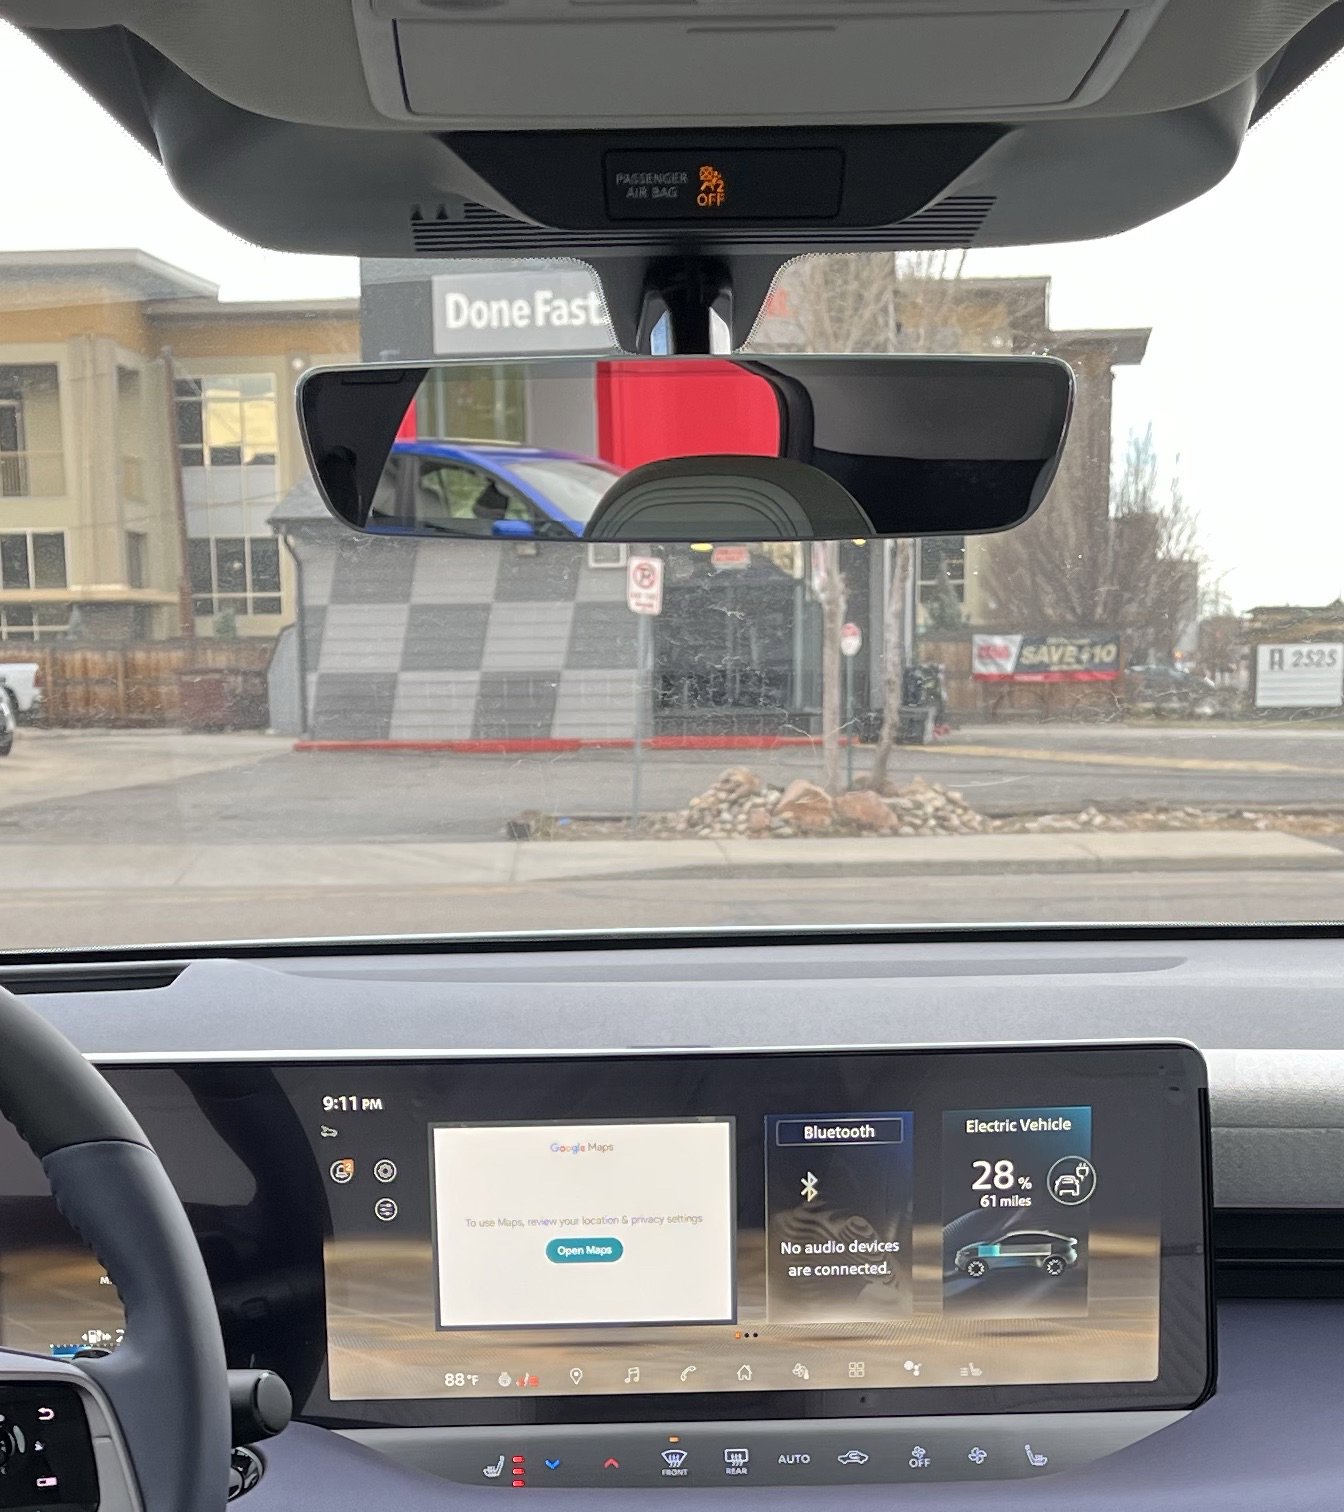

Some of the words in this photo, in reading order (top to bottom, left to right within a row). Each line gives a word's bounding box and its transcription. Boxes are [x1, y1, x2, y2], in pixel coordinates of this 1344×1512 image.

[616, 171, 689, 184] PASSENGER
[626, 187, 648, 199] AIR
[651, 187, 678, 199] BAG
[697, 193, 725, 207] OFF
[444, 291, 532, 329] Done
[534, 289, 610, 328] Fast
[322, 1096, 358, 1111] 9:11
[361, 1098, 383, 1111] PM
[966, 1119, 1017, 1134] Electric
[1019, 1117, 1072, 1132] Vehicle
[804, 1125, 876, 1141] Bluetooth
[550, 1142, 586, 1155] Google
[588, 1142, 614, 1154] Maps
[971, 1160, 1015, 1190] 28
[1018, 1176, 1032, 1190] %
[980, 1194, 997, 1208] 61
[1000, 1194, 1032, 1207] miles
[466, 1217, 477, 1227] To
[479, 1219, 495, 1227] use
[527, 1216, 557, 1226] review
[559, 1218, 579, 1229] your
[582, 1215, 619, 1225] location
[621, 1215, 629, 1225] &
[631, 1215, 665, 1228] privacy
[667, 1213, 703, 1226] settings
[557, 1244, 584, 1257] Open
[586, 1244, 613, 1257] Maps
[780, 1241, 801, 1255] No
[805, 1240, 845, 1254] audio
[848, 1239, 900, 1254] devices
[788, 1265, 811, 1277] are
[814, 1261, 892, 1276] connected.
[444, 1373, 465, 1387] 88
[778, 1454, 811, 1465] AUTO
[909, 1458, 931, 1468] OFF
[661, 1468, 688, 1477] FRONT
[725, 1467, 748, 1476] REAR
